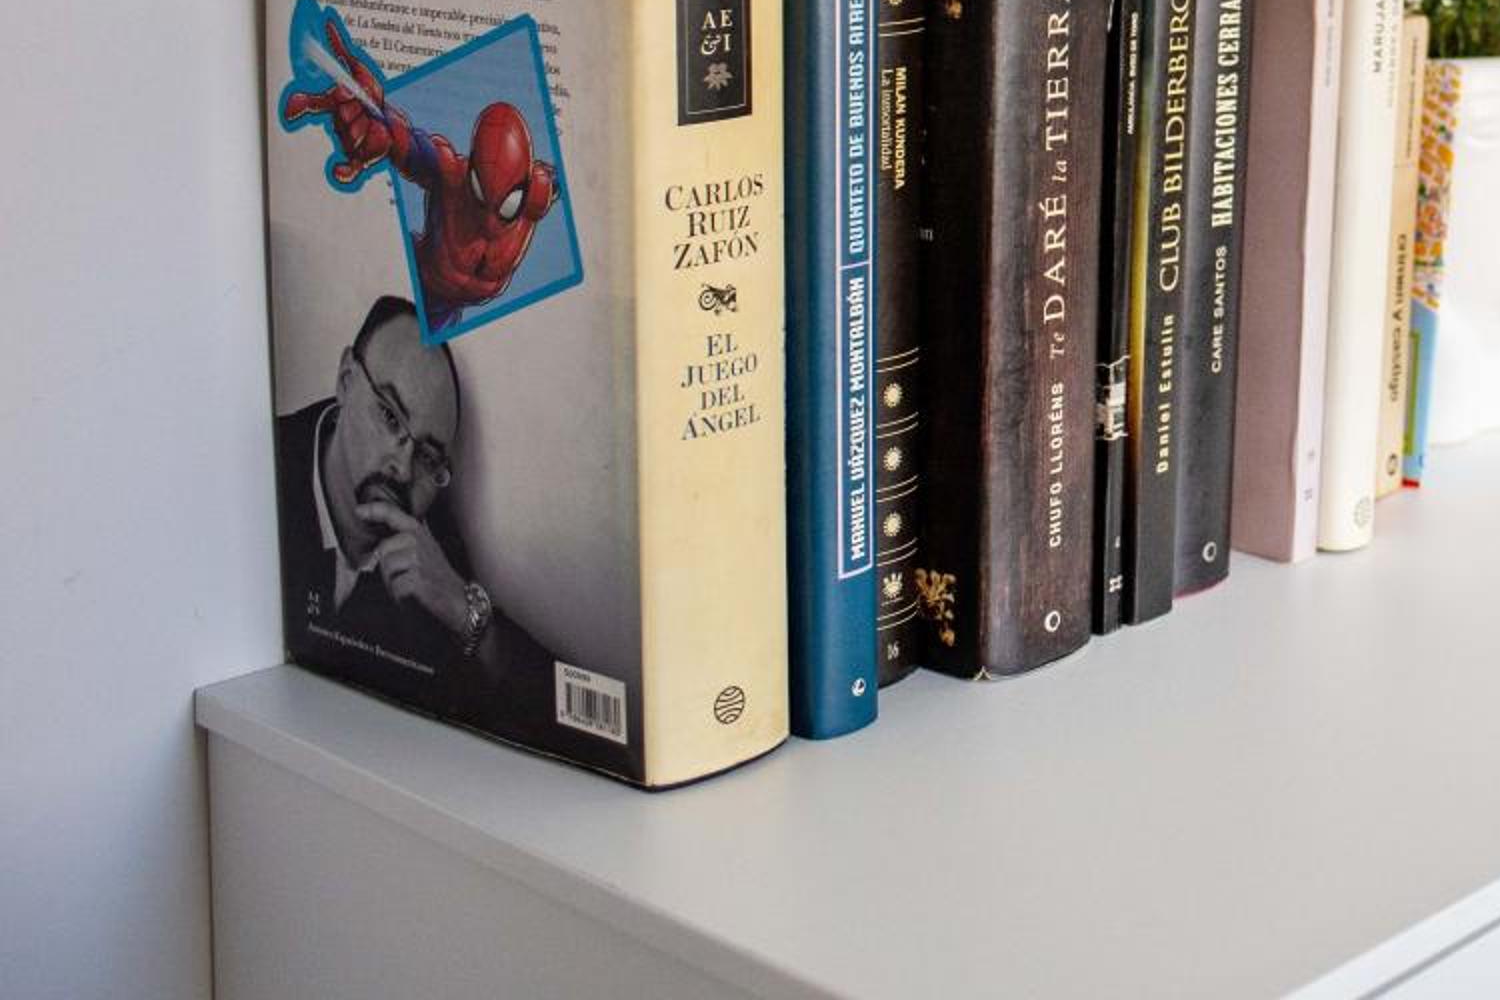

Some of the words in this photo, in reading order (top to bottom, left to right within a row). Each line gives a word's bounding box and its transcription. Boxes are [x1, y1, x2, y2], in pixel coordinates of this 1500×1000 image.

[702, 9, 733, 29] AE
[1372, 0, 1386, 73] MARUJA
[848, 51, 866, 127] BUENOS
[881, 69, 894, 87] La
[895, 67, 907, 114] MILAN
[848, 133, 866, 158] DE
[894, 117, 907, 189] KUNDERA
[1050, 160, 1067, 183] la
[1211, 73, 1239, 228] HABITACIONES
[664, 174, 763, 211] CARLOS
[687, 206, 751, 238] RUIZ
[848, 163, 866, 254] QUINTETO
[674, 228, 759, 270] ZAFÓN
[1037, 194, 1067, 324] DARÉ
[1159, 203, 1181, 292] CLUB
[1212, 246, 1228, 318] SANTOS
[706, 333, 738, 357] EL
[846, 276, 866, 391] MONTALBÁN
[1049, 331, 1066, 360] Te
[1157, 313, 1175, 393] Estulin
[1210, 324, 1225, 374] CARE
[681, 353, 758, 388] JUEGO
[700, 384, 745, 411] DEL
[681, 404, 761, 440] ÁNGEL
[846, 395, 866, 479] VÁZQUEZ
[1046, 381, 1065, 476] LLORÉNS
[1155, 402, 1172, 473] Daniel
[850, 482, 866, 560] MANUEL
[1048, 482, 1063, 548] CHUFO
